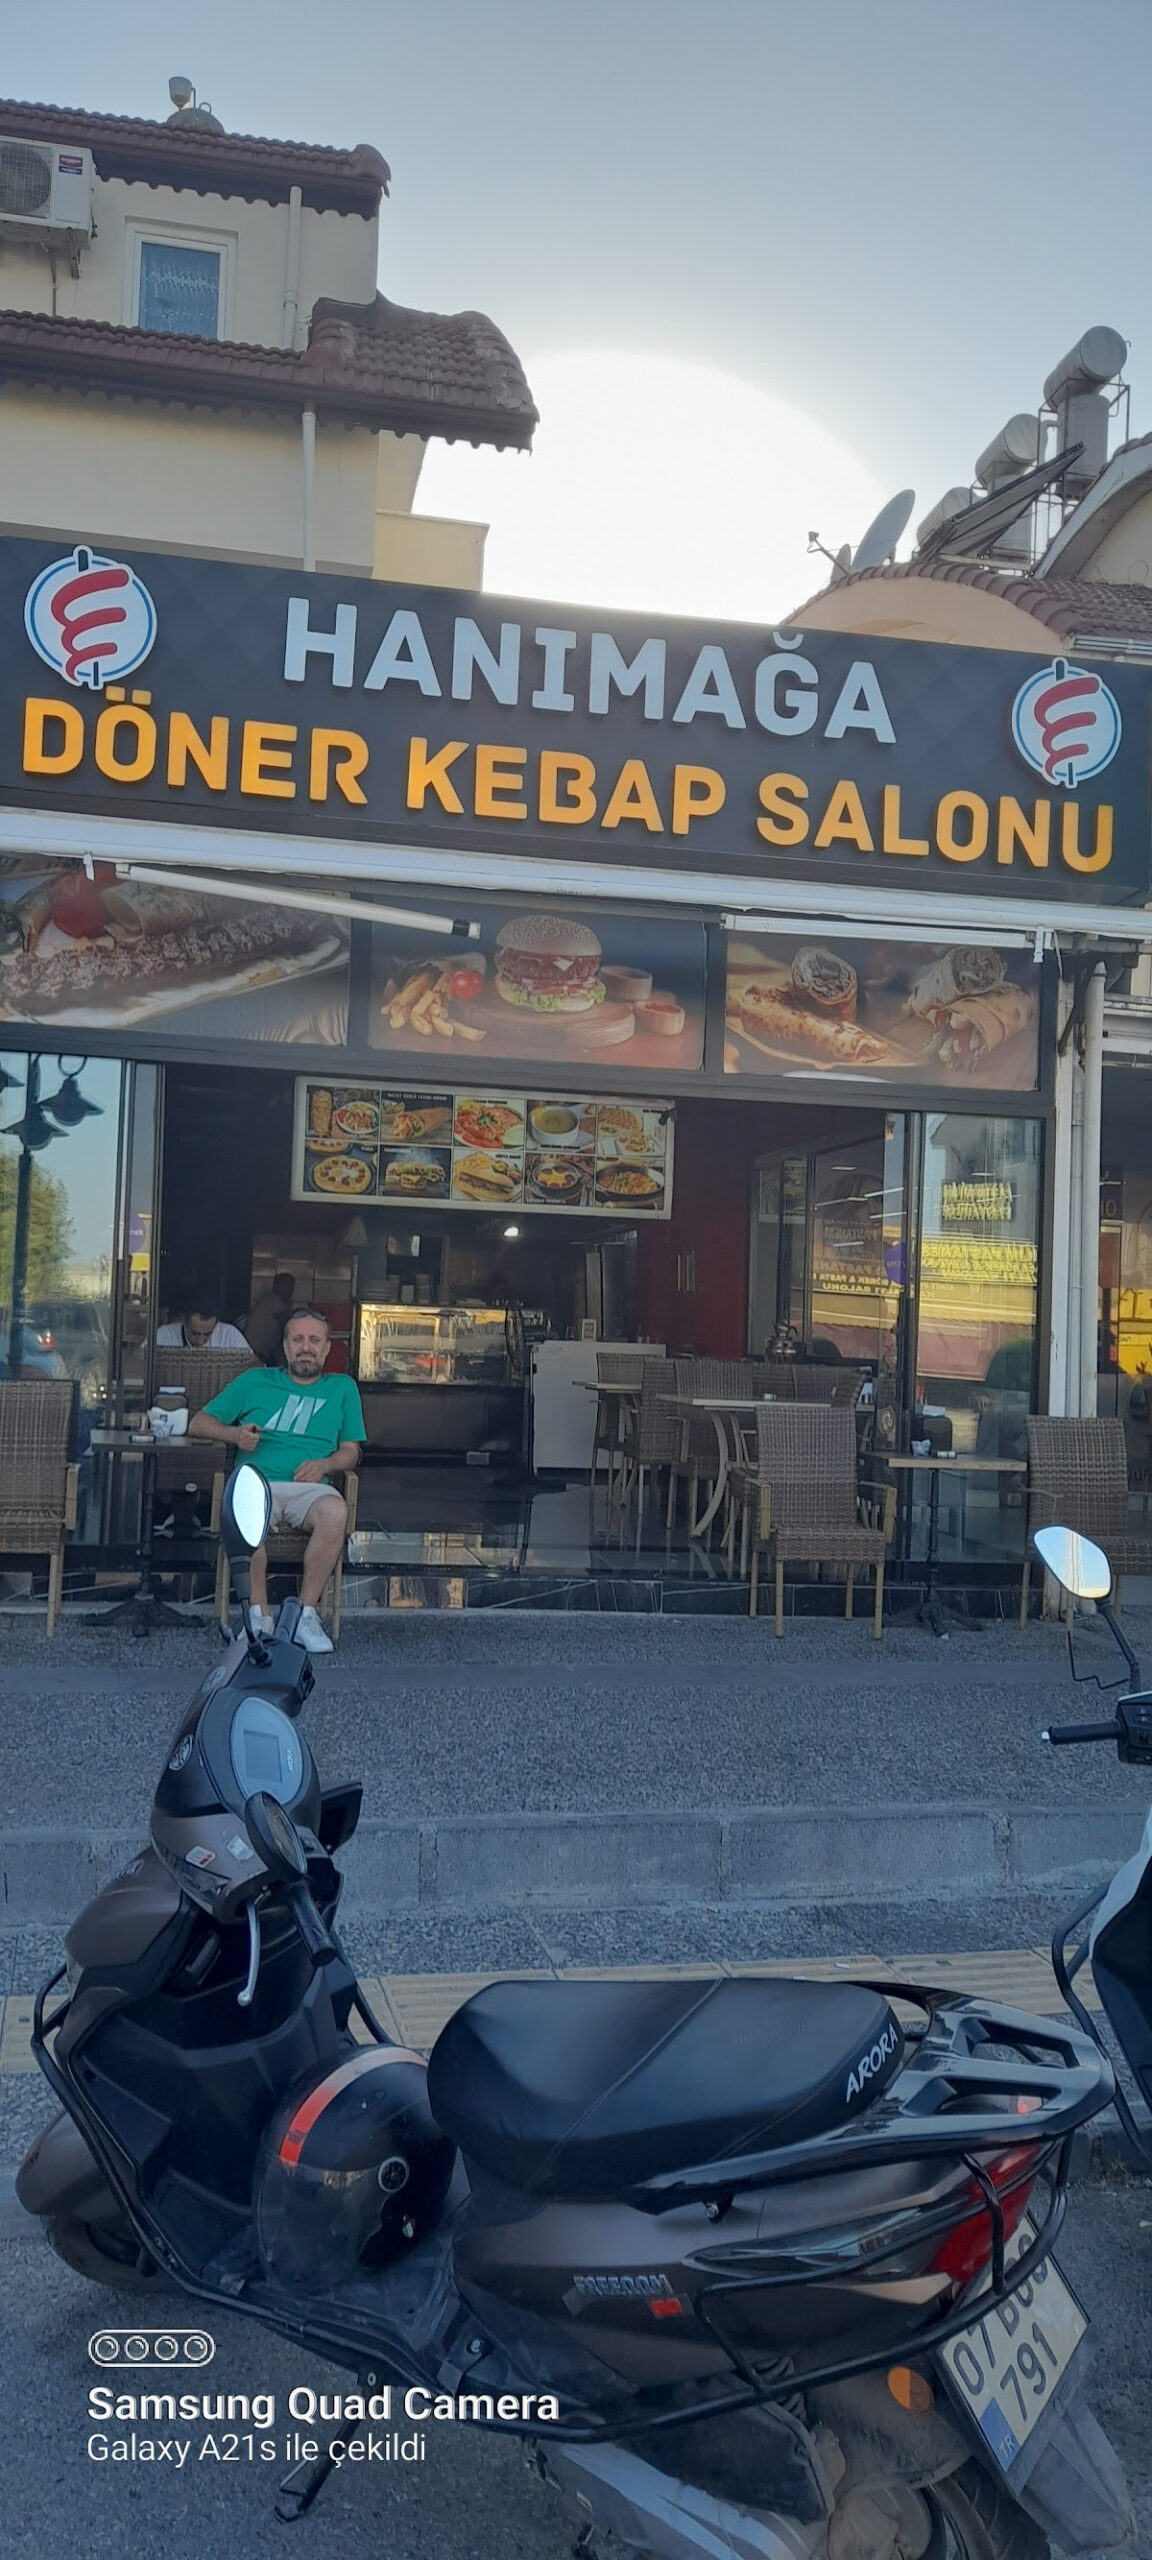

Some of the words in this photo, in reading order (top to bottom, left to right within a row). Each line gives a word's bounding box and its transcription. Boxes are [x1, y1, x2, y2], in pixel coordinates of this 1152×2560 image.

[284, 598, 897, 745] HANIMAĞA
[22, 688, 369, 806] DÖNER
[406, 738, 727, 835] KEBAP
[757, 773, 1114, 874] SALONU
[846, 2021, 899, 2104] ARORA
[999, 2322, 1058, 2422] 791
[999, 2434, 1016, 2459] TR
